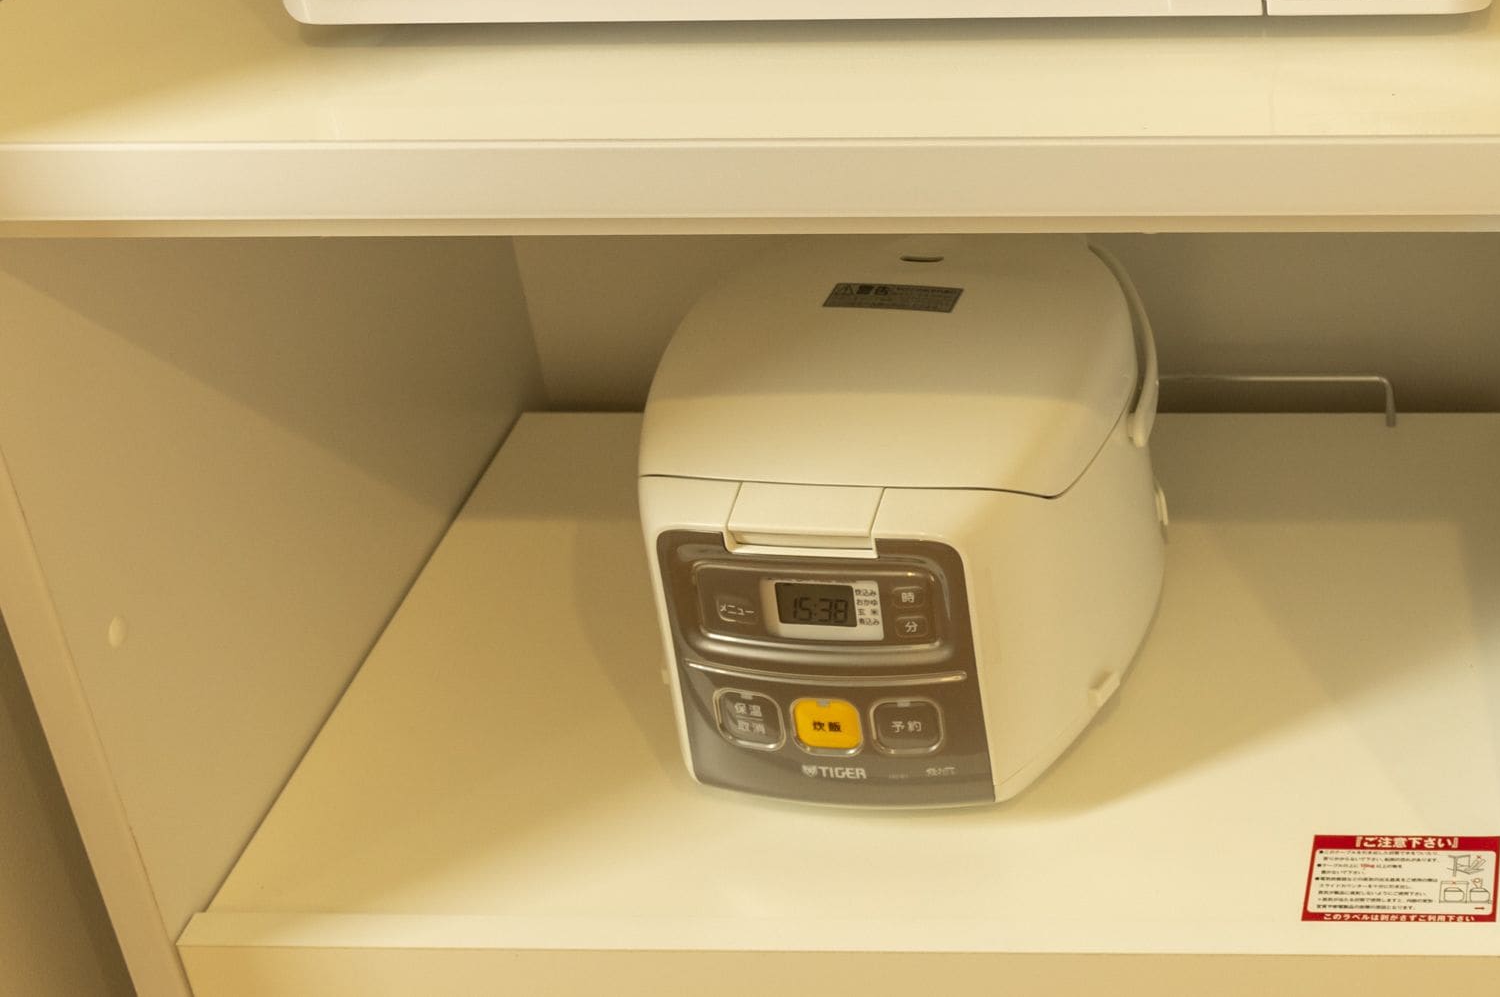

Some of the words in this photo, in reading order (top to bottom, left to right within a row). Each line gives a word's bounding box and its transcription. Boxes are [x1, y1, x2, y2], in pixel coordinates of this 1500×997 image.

[719, 604, 754, 616] メニュー
[905, 621, 918, 632] 分
[812, 720, 842, 733] 炊飯
[891, 720, 922, 732] 予約
[818, 766, 867, 779] TIGER
